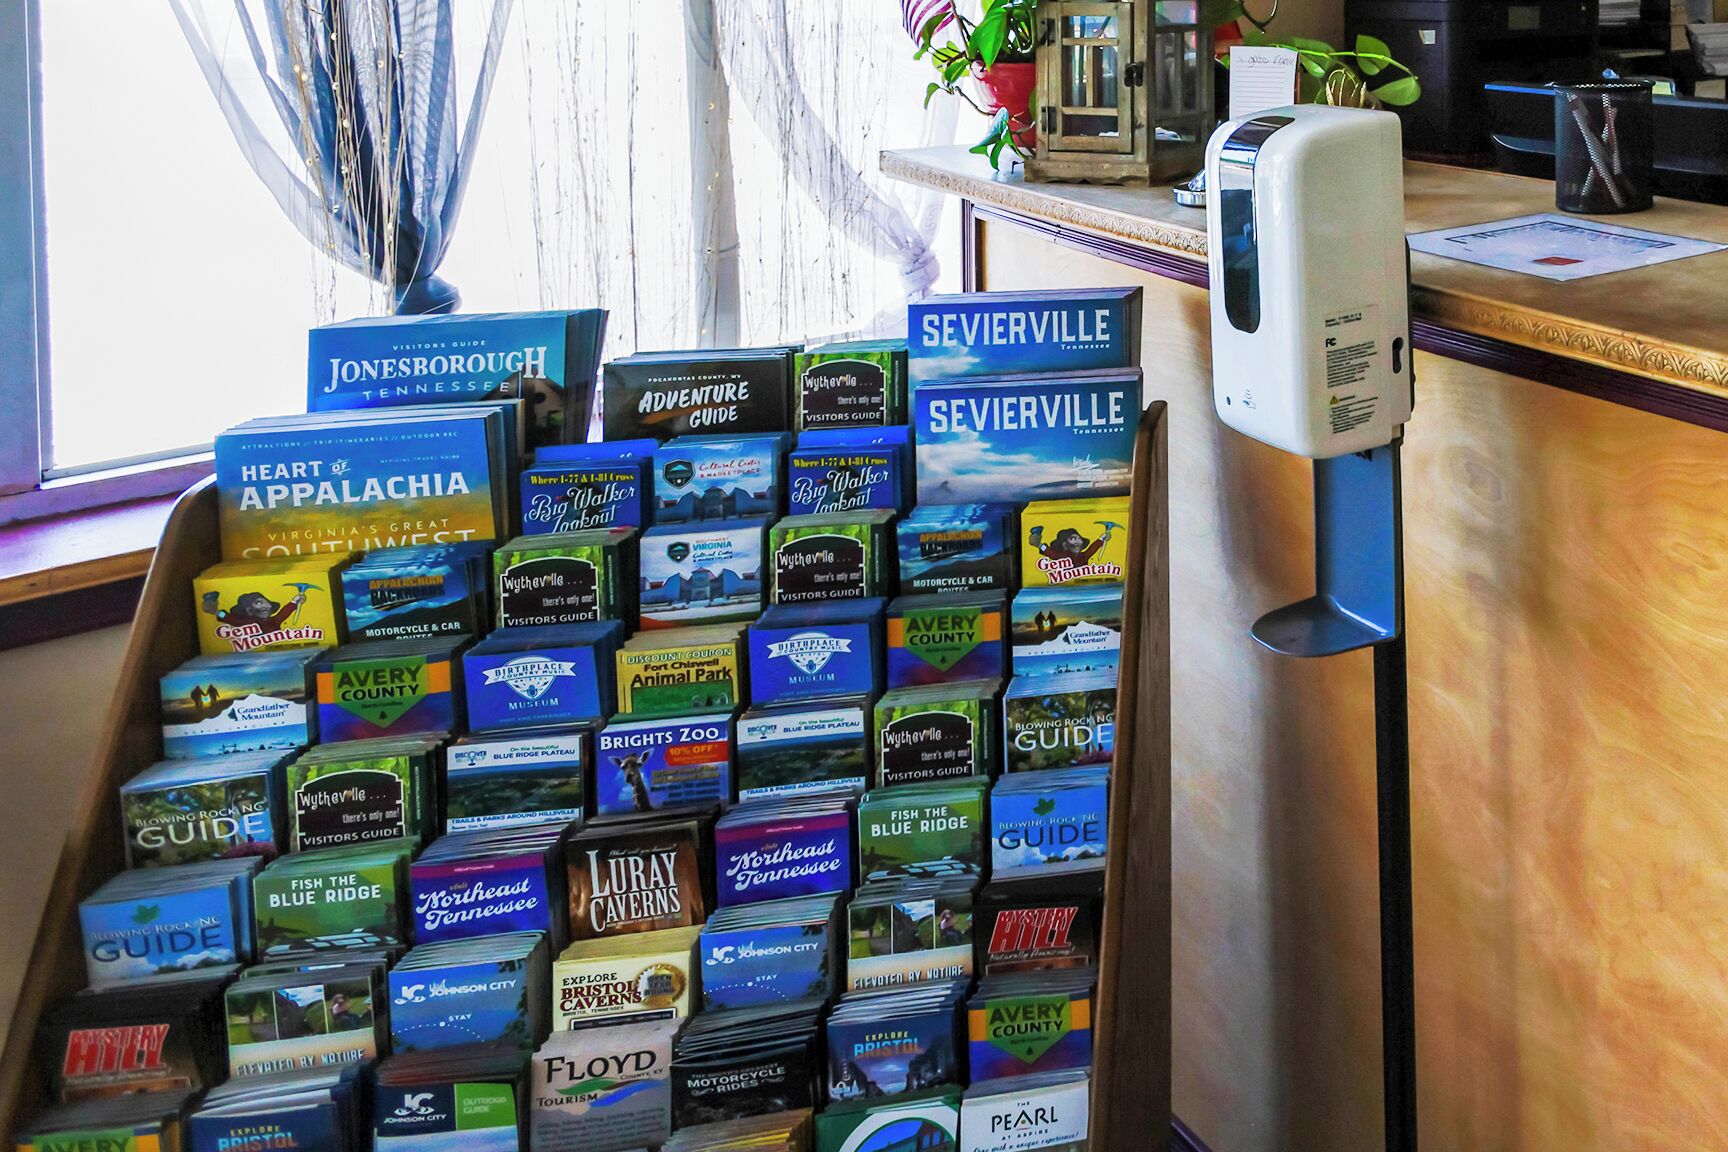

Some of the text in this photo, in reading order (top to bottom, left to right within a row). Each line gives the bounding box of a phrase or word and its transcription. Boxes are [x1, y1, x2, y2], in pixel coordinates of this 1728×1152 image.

[922, 309, 1110, 347] SEVIERVILLE
[393, 341, 446, 350] VISITORS
[324, 347, 547, 394] JONESBOROUGH
[363, 381, 510, 400] TENNESSEE
[638, 381, 750, 414] ADVENTURE
[689, 406, 738, 429] GUIDE
[807, 410, 881, 421] VISITORS GUIDE
[929, 391, 1124, 433] SEVIERVILLE
[242, 461, 348, 481] HEART OF
[239, 471, 470, 511] APPALACHIA
[792, 466, 889, 503] Big Walker
[526, 483, 635, 522] Big Walker
[268, 518, 448, 541] VIRGINIA'S GREAT
[692, 540, 732, 551] VIRGINIA
[1036, 557, 1073, 572] Gem
[1048, 562, 1122, 584] Mountain
[913, 578, 967, 587] MOTORCYCLE
[976, 575, 993, 584] CAR
[215, 621, 262, 641] Gem
[366, 621, 460, 637] MOTORCYCLE & CAR
[906, 615, 978, 633] AVERY
[232, 627, 323, 653] Mountain
[909, 630, 976, 646] COUNTY
[1069, 630, 1110, 639] Grandfather
[627, 648, 731, 664] DISCOUNT COUPON
[337, 664, 422, 689] AVERY
[632, 666, 732, 687] Animal Park
[644, 663, 668, 672] Fort
[789, 674, 835, 684] MUSEUM
[341, 684, 419, 703] COUNTY
[828, 721, 859, 729] PLATEAU
[600, 727, 719, 750] BRIGHTS ZOO
[1014, 723, 1114, 751] GUIDE
[541, 749, 575, 757] PLATEAU
[507, 812, 537, 820] AROUND
[538, 809, 575, 818] HILLSVILLE
[891, 807, 947, 821] FISH THE
[136, 813, 265, 849] GUIDE
[871, 816, 968, 837] BLUE RIDGE
[726, 838, 836, 877] Northeast
[291, 874, 357, 890] FISH THE
[587, 849, 677, 898] LURAY
[735, 858, 842, 891] Tennessee
[270, 885, 381, 908] BLUE RIDGE
[416, 877, 530, 913] Northeast
[590, 887, 681, 932] CAVERNS
[998, 907, 1078, 929] MYSTERY
[988, 922, 1071, 954] HILL
[563, 973, 617, 986] EXPLORE
[756, 974, 777, 982] STAY
[561, 980, 636, 1000] BRISTOL
[560, 992, 642, 1012] CAVERNS
[989, 1003, 1065, 1024] AVERY
[70, 1025, 170, 1051] MYSTERY
[865, 1031, 909, 1041] EXPLORE
[993, 1020, 1064, 1037] COUNTY
[854, 1038, 922, 1058] BRISTOL
[63, 1040, 166, 1077] HILL
[544, 1050, 657, 1084] FLOYD
[687, 1067, 785, 1088] MOTORCYCLE
[717, 1079, 759, 1094] RIDES
[537, 1093, 598, 1107] TOURISM
[384, 1113, 446, 1124] JOHNSON CITY
[991, 1106, 1058, 1133] PEARL
